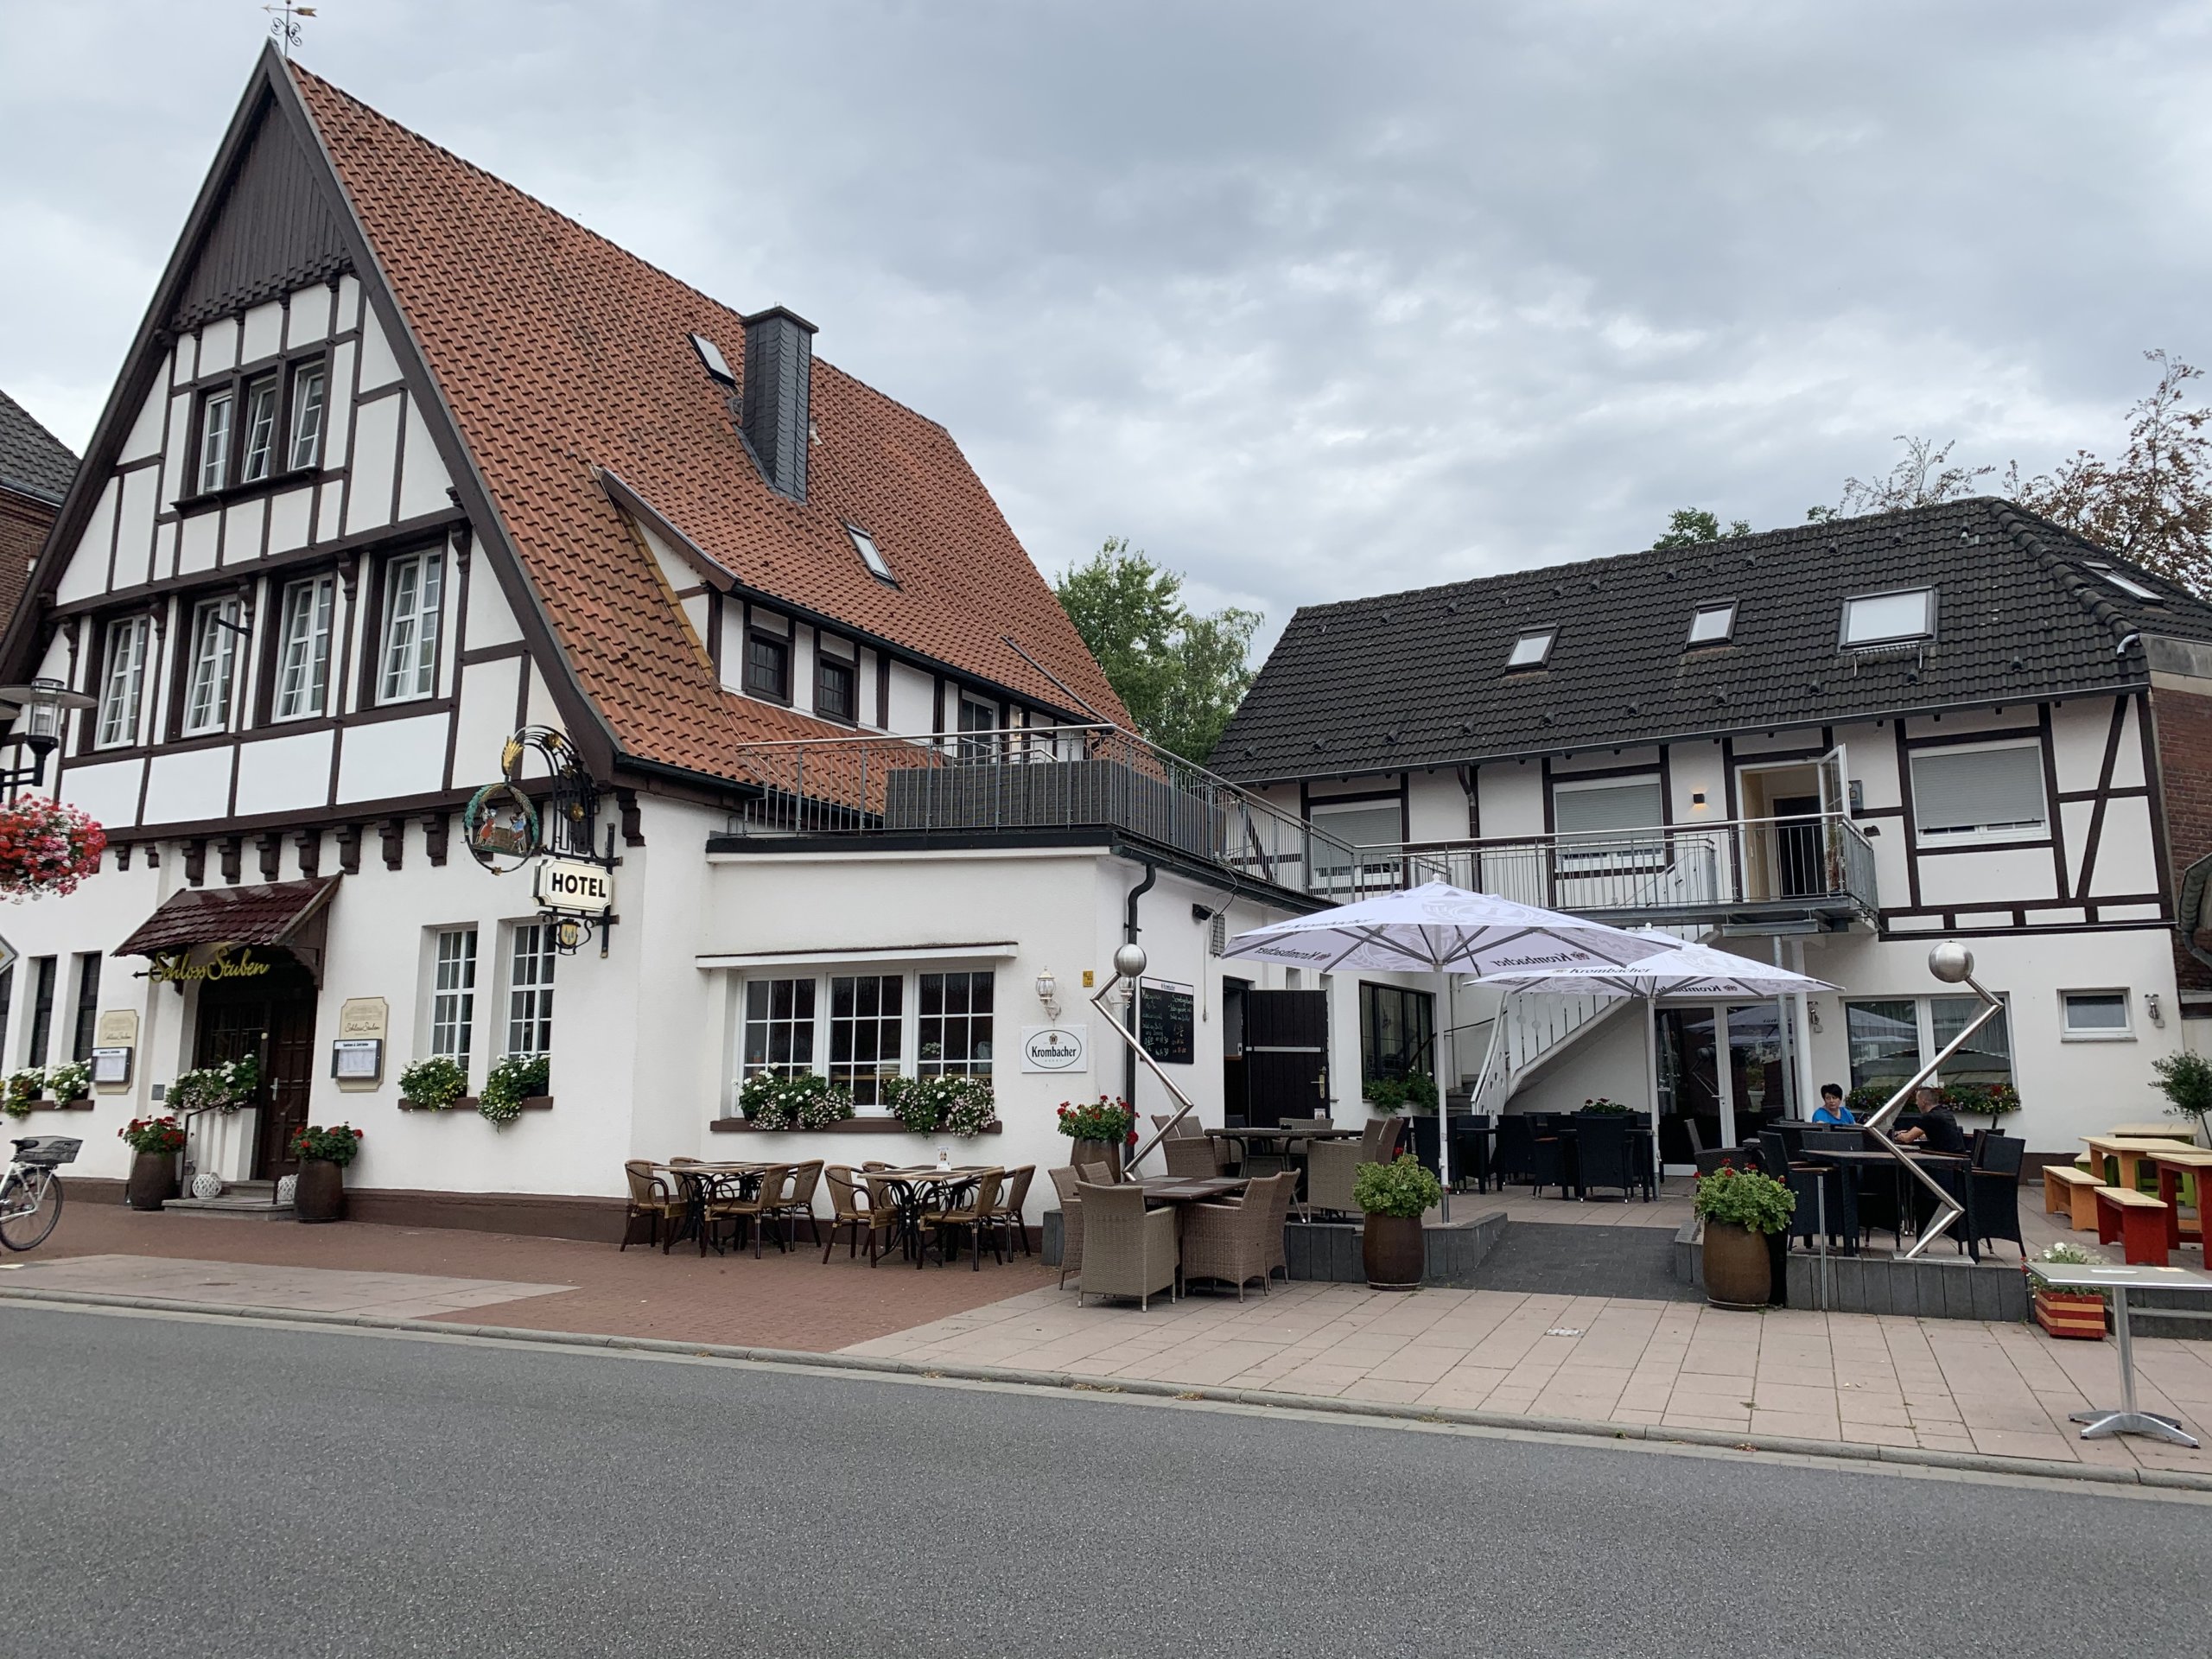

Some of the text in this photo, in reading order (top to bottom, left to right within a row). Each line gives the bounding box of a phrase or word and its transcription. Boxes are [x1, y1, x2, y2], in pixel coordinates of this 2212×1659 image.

[551, 872, 607, 899] HOTEL
[148, 947, 271, 983] Schloss Stuben
[1569, 966, 1653, 975] Krombacher
[1031, 1046, 1077, 1058] Krombacher
